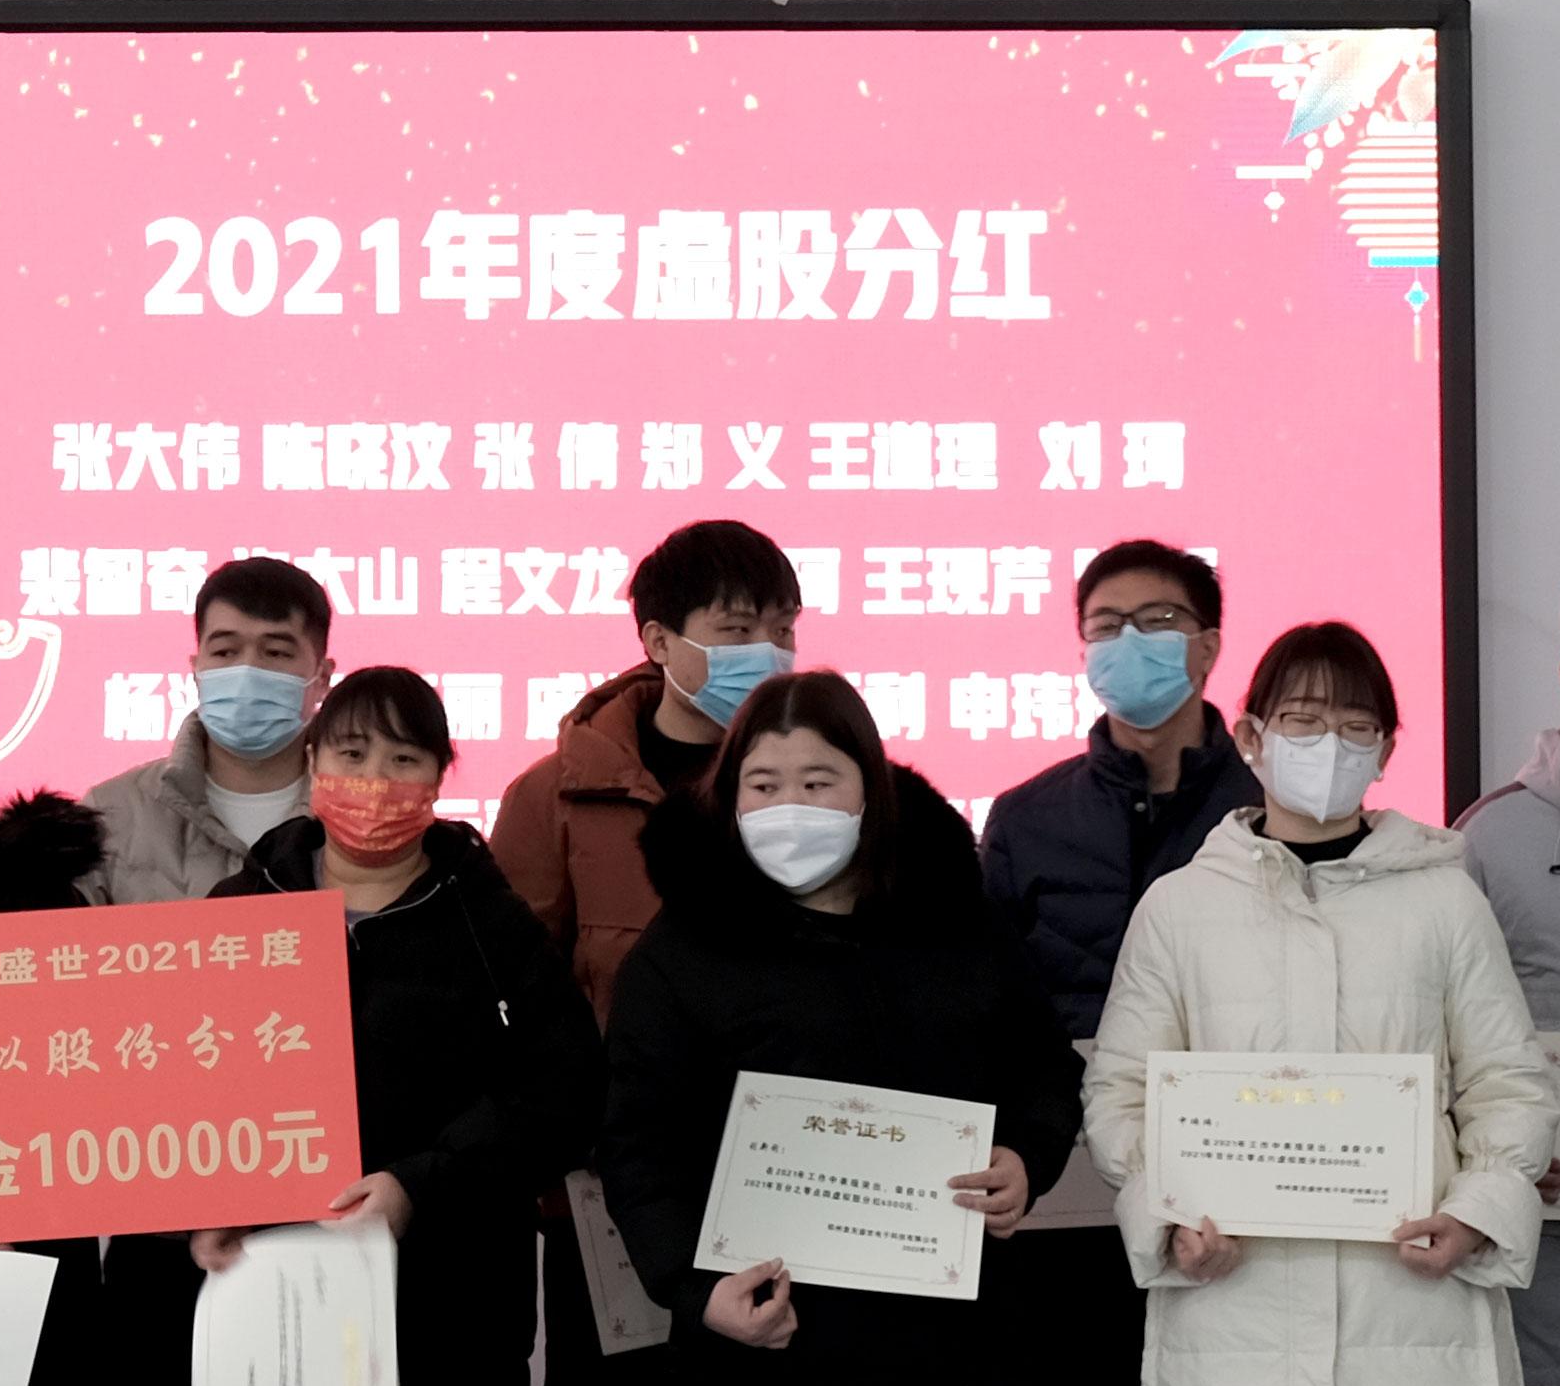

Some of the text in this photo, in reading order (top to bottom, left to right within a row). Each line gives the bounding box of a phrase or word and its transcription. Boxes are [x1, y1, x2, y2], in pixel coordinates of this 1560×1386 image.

[143, 208, 1051, 320] 2021年度虚股分红
[52, 422, 241, 491] 张大伟
[440, 546, 629, 616] 程文龙
[802, 1114, 907, 1143] 荣誉证书
